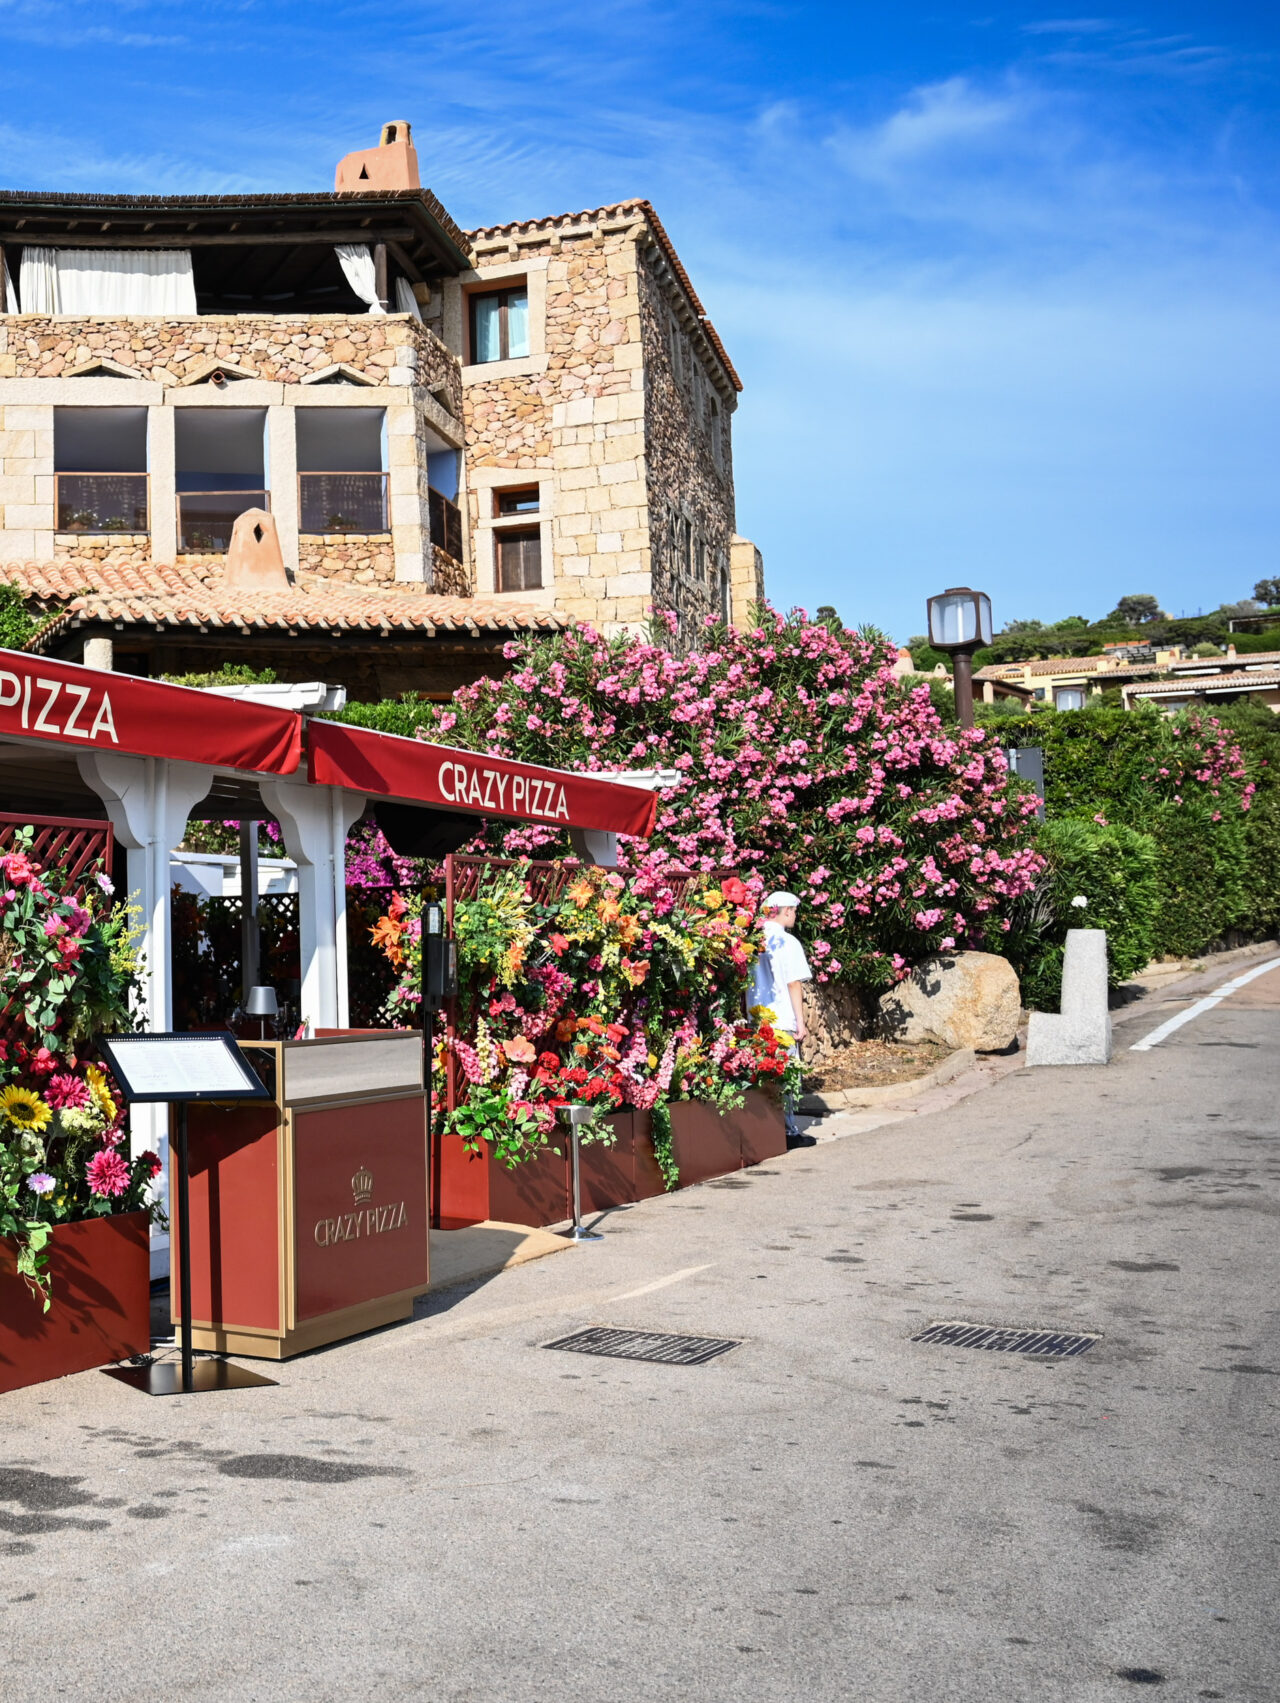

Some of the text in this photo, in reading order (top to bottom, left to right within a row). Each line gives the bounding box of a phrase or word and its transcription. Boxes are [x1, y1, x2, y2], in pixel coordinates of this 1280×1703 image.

[439, 762, 569, 820] CRAZY PIZZA
[314, 1201, 408, 1247] CRAZY PIZZA
